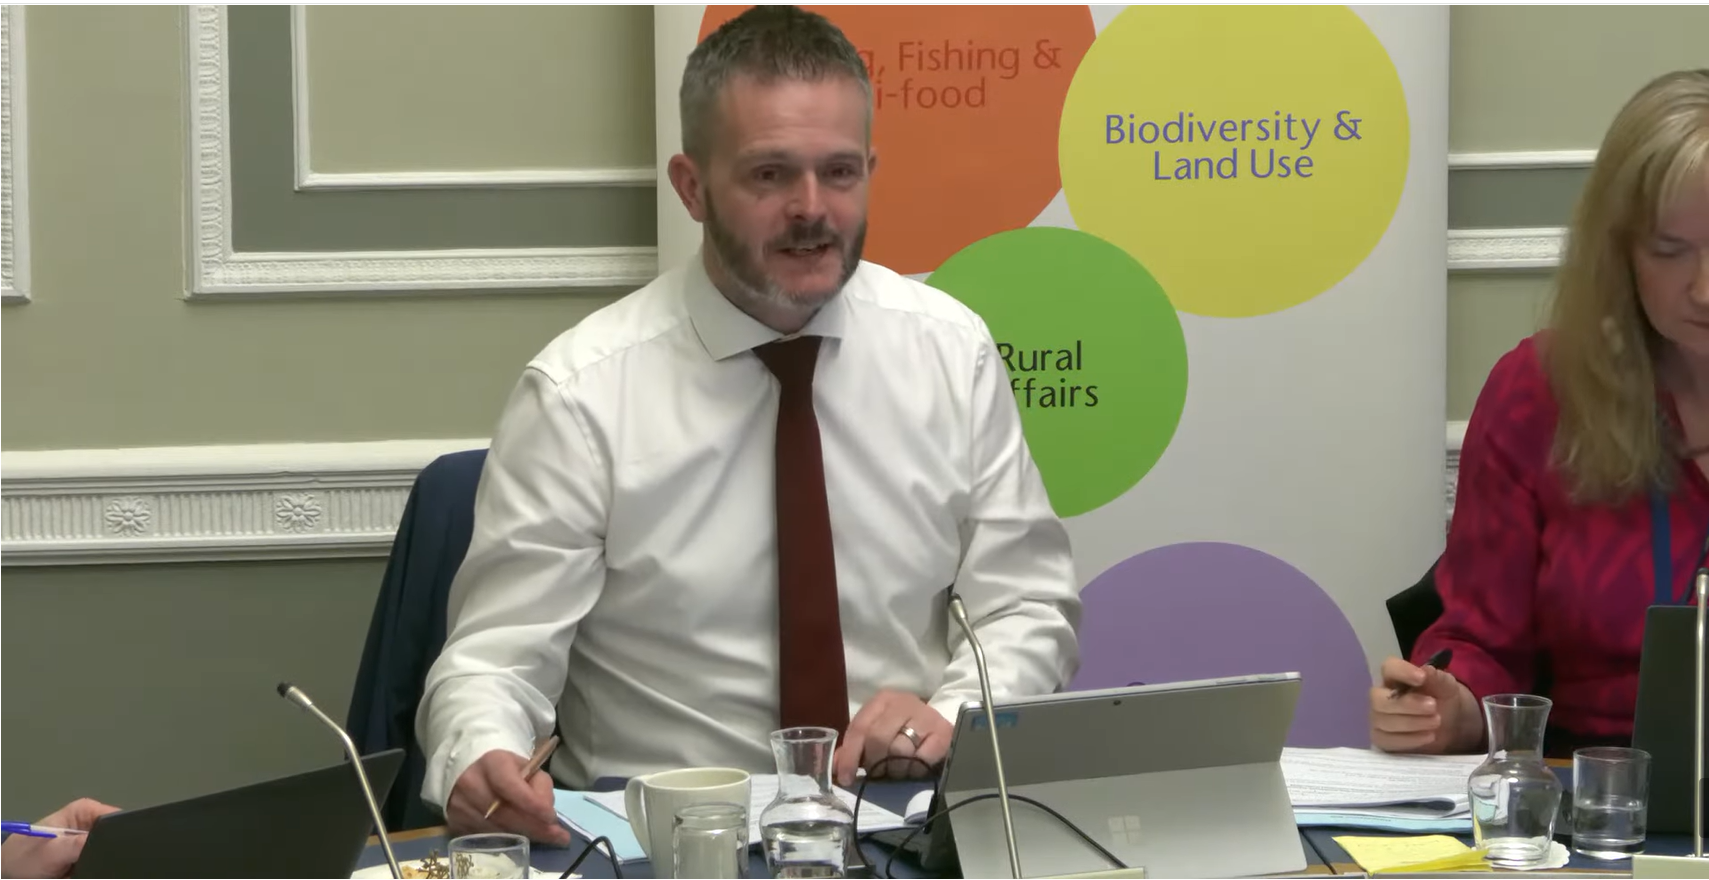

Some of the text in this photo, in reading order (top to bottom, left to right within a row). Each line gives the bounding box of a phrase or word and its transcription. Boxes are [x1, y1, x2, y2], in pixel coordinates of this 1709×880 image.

[898, 39, 1020, 80] Fishing
[1032, 38, 1063, 70] &
[875, 75, 987, 110] i-food
[1105, 109, 1363, 151] Biodiversity &
[1153, 147, 1315, 181] Land Use
[995, 339, 1083, 372] Rural
[1009, 377, 1100, 409] ffairs
